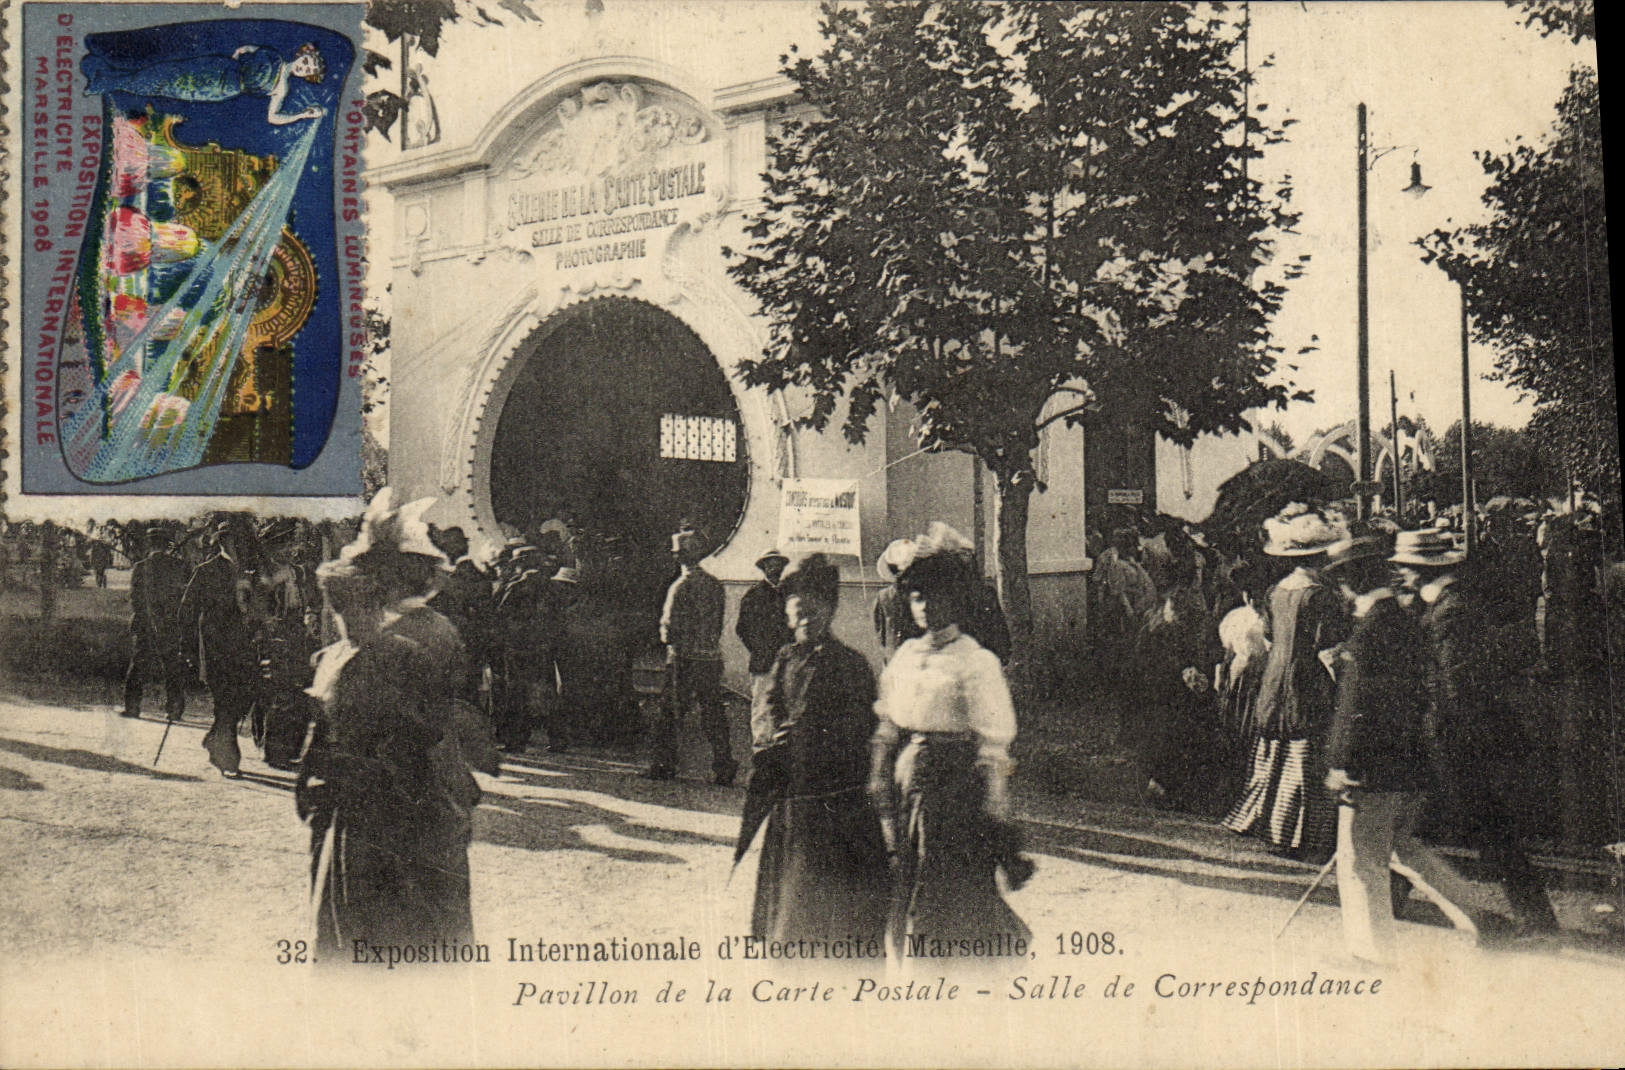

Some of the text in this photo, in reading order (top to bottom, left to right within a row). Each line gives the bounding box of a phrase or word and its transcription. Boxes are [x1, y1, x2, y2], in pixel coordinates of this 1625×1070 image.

[31, 56, 52, 252] MARSEILLE 1908
[648, 161, 706, 207] POSTALE
[35, 115, 101, 446] EXPOSITION INTERNATIONALE
[342, 99, 365, 379] FONTAINES LUMINEUSES
[531, 207, 679, 248] SALLE DE CORRESPONDANCE
[556, 238, 647, 271] PHOTOGRAPHIE
